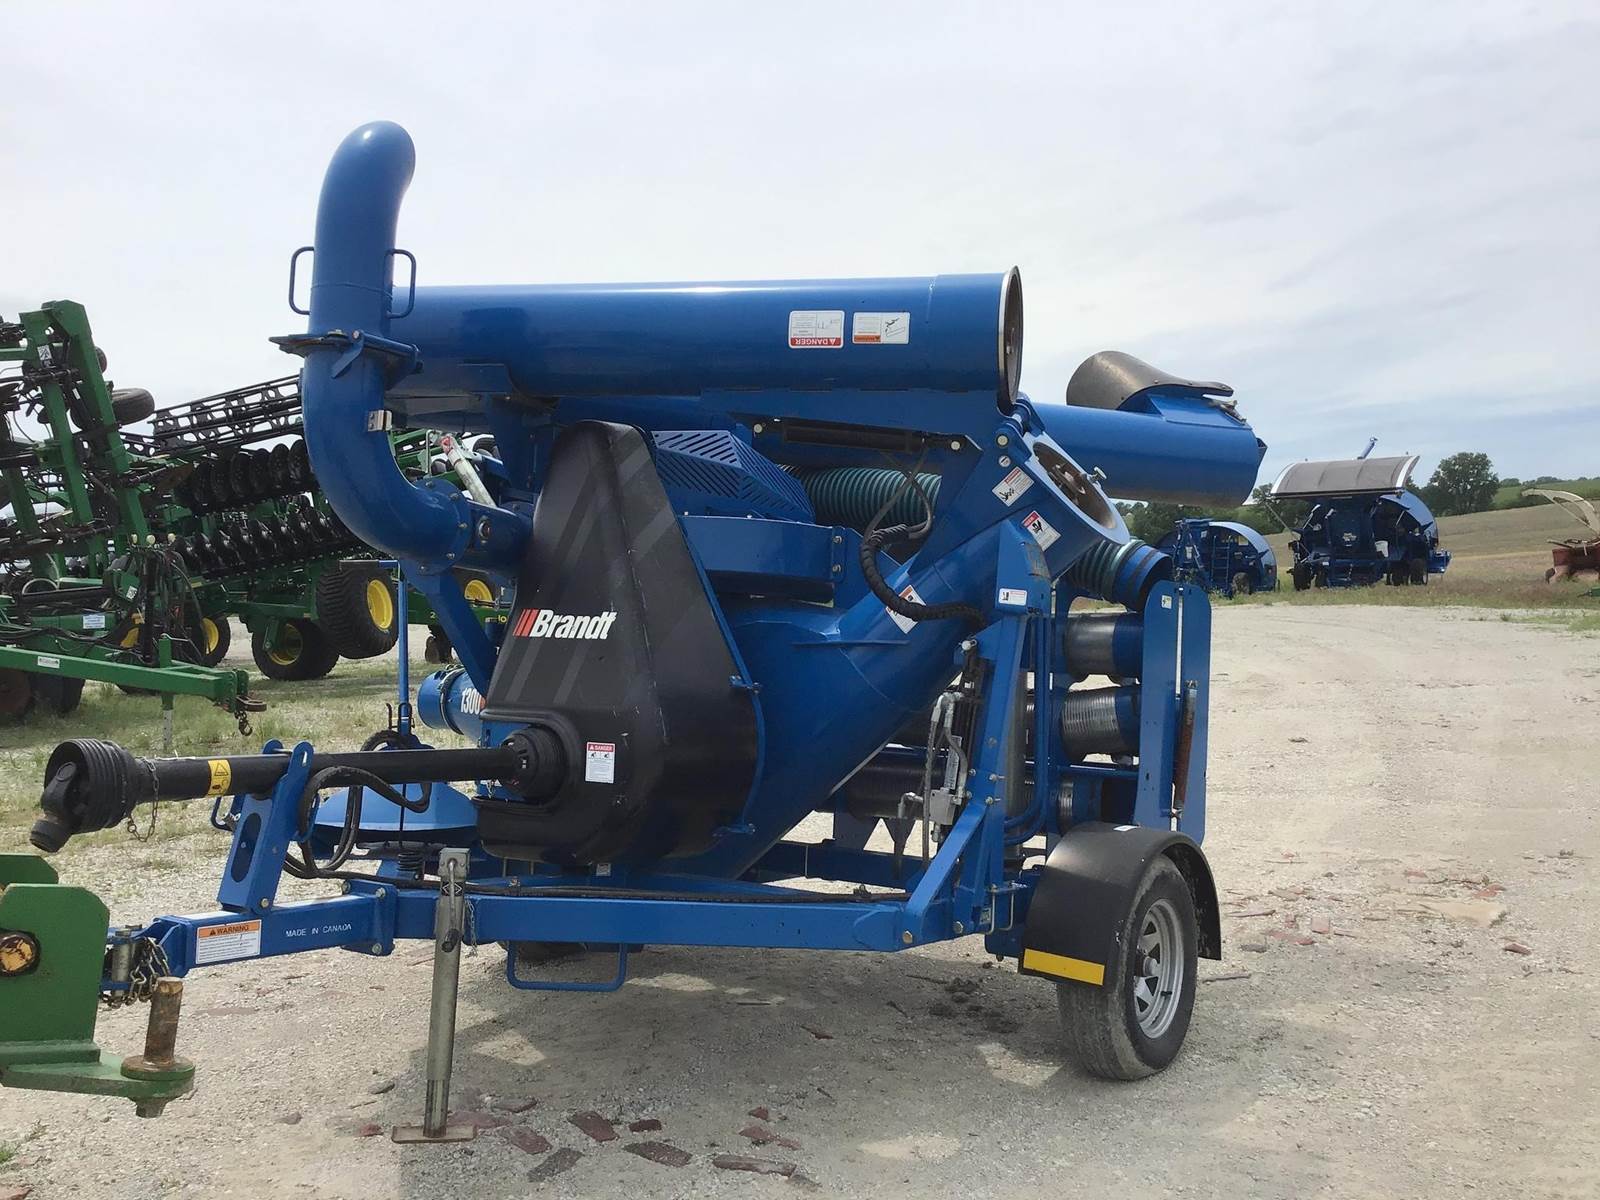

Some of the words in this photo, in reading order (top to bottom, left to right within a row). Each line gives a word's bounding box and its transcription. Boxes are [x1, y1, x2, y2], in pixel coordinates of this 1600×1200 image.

[529, 609, 618, 640] Brandt
[217, 924, 249, 935] WARNING
[285, 928, 307, 937] MADE
[311, 927, 319, 935] IN
[322, 923, 352, 934] CANADA
